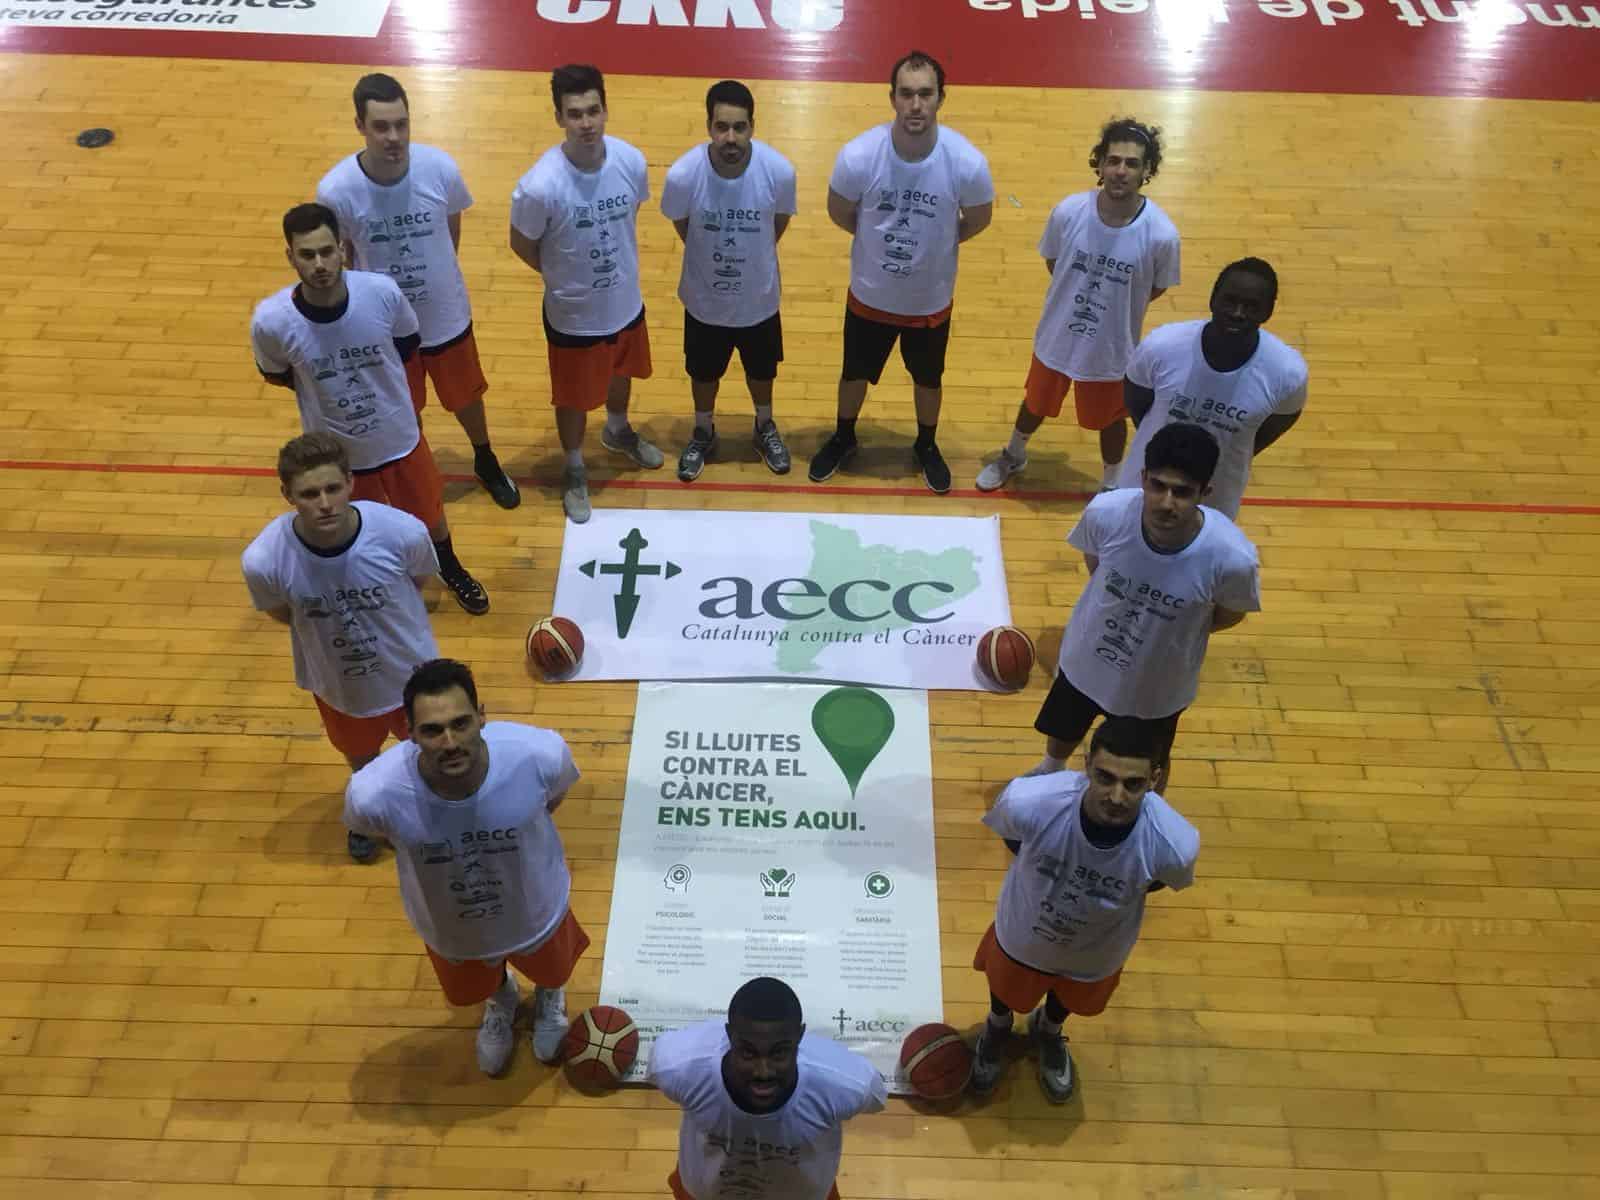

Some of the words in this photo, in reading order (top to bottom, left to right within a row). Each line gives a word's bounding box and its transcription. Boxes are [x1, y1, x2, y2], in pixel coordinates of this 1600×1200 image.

[71, 9, 239, 25] corredoria
[1257, 0, 1366, 26] de
[597, 194, 629, 211] aecc
[903, 188, 938, 206] aecc
[393, 211, 433, 226] aecc
[726, 208, 760, 221] aecc
[1097, 254, 1135, 274] aecc
[340, 344, 381, 359] aecc
[1202, 397, 1249, 421] aecc
[335, 586, 384, 601] aecc
[698, 576, 956, 624] aecc
[1137, 583, 1186, 609] aecc
[682, 623, 790, 647] Catalunya
[800, 629, 864, 643] contra
[874, 627, 891, 645] el
[903, 628, 977, 647] Càncer
[664, 731, 689, 750] SI
[696, 731, 801, 752] LLUITES
[663, 756, 769, 777] CONTRA
[775, 758, 808, 777] EL
[660, 776, 774, 806] CÀNCER,
[657, 806, 711, 827] ENS
[718, 807, 787, 829] TENS
[461, 827, 518, 842] aecc
[1073, 865, 1126, 892] aecc
[855, 1019, 905, 1033] aecc
